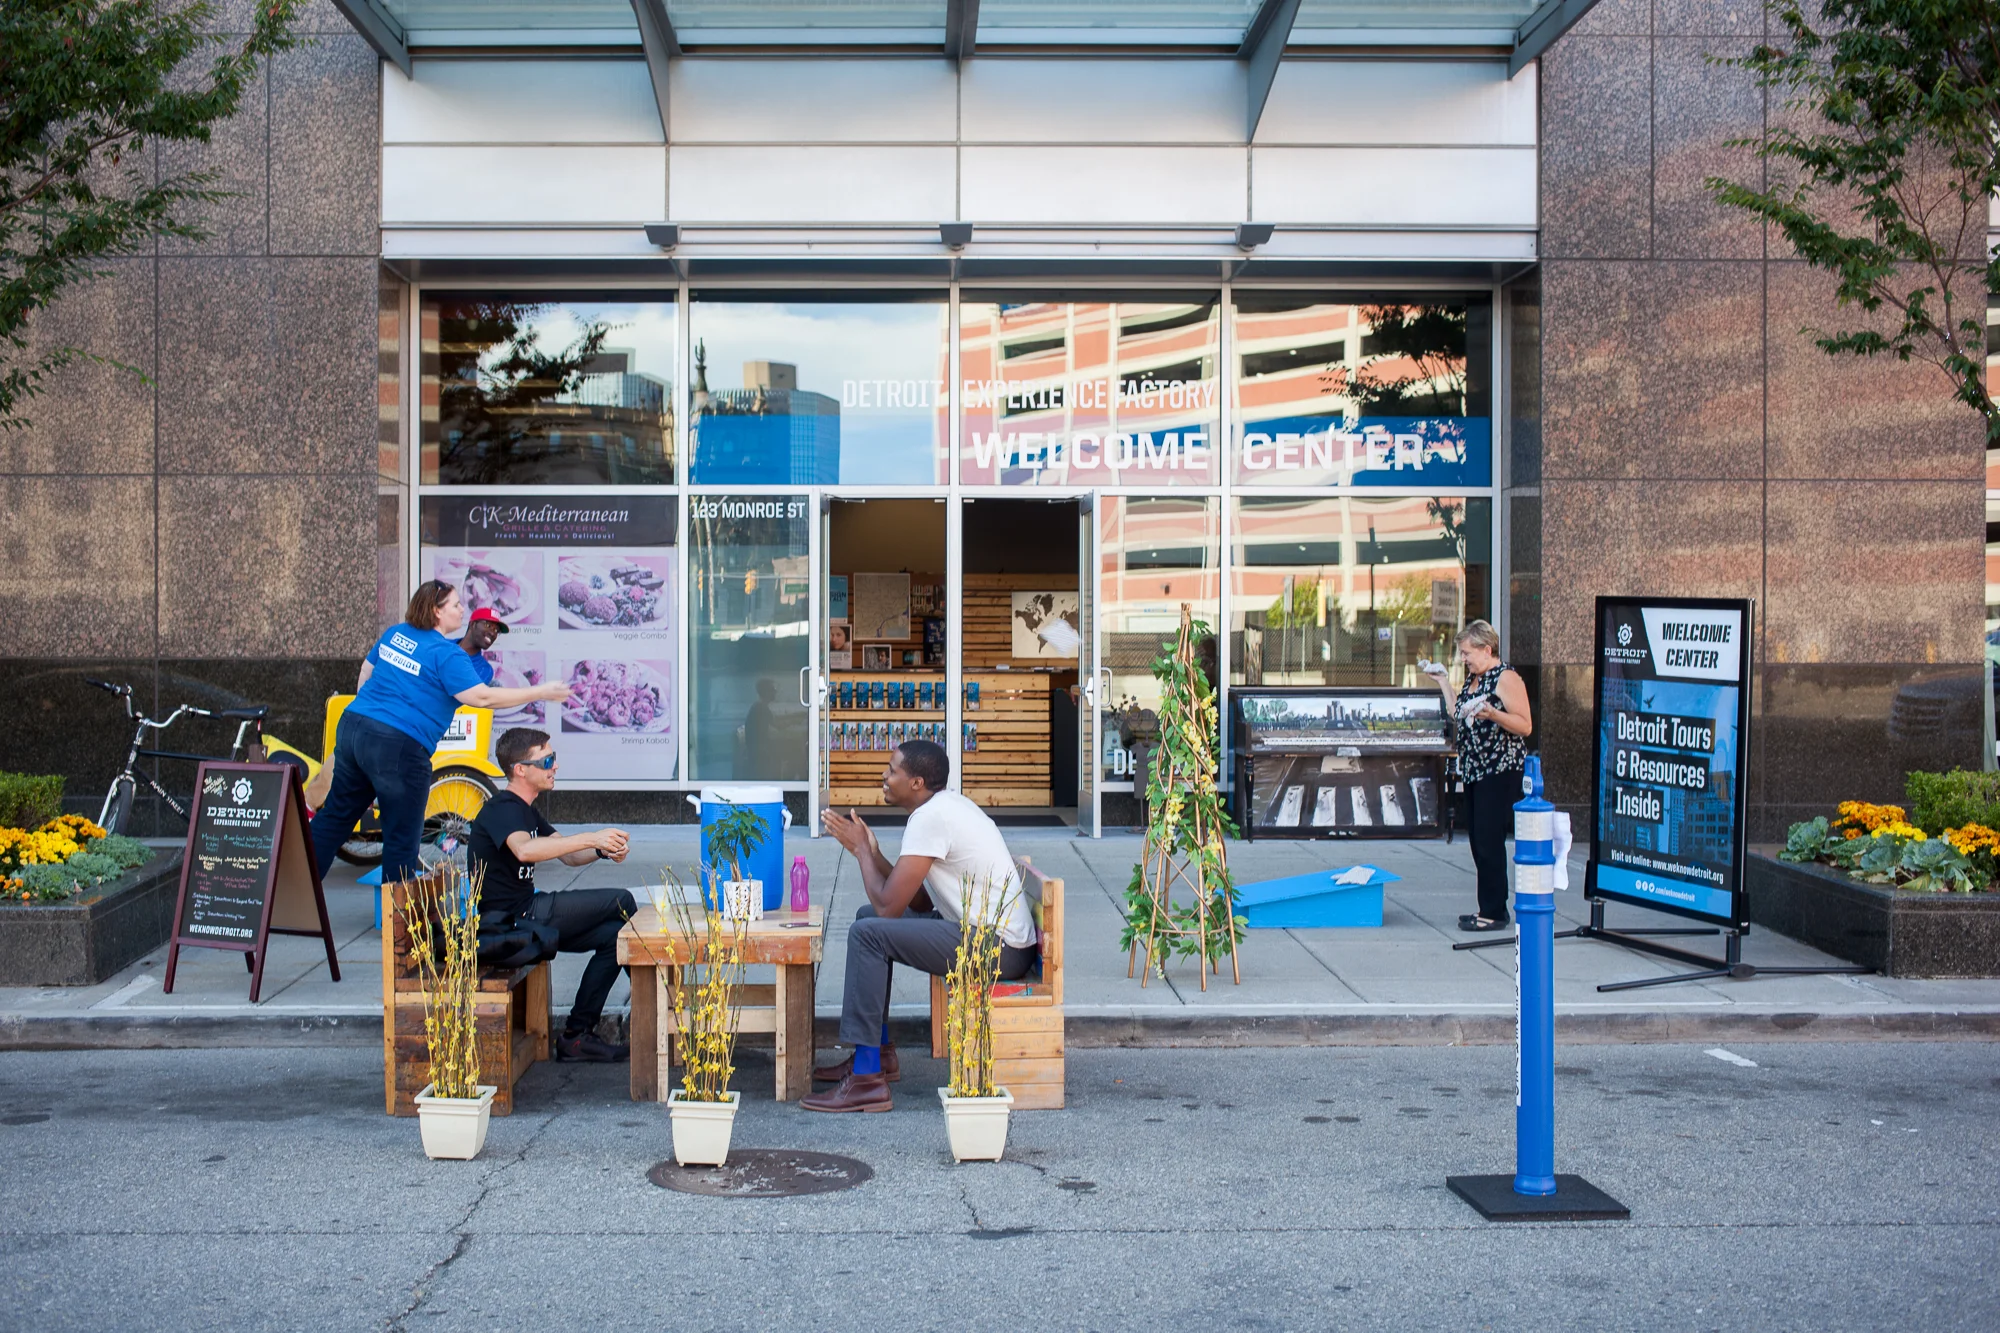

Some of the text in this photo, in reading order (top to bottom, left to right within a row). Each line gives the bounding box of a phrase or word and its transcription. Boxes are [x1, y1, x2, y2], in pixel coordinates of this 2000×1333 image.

[843, 379, 1214, 409] DETROIT EXPERIENCE FACTORY
[972, 432, 1423, 471] WELCOME CENTER
[508, 504, 629, 523] Mediterranean
[692, 502, 805, 518] 123 MONROE ST
[502, 524, 607, 532] GRILLE & CATERING
[529, 532, 561, 541] Healthy
[523, 627, 542, 636] Wrap
[613, 632, 667, 641] Veggie Combo
[1662, 622, 1732, 644] WELCOME
[1604, 647, 1647, 658] DETROIT
[1665, 648, 1718, 669] CENTER
[621, 736, 644, 745] Shrimp
[1617, 712, 1711, 750] Detroit Tours
[1616, 750, 1705, 789] & Resources
[150, 780, 185, 815] MAIN STREET
[1615, 787, 1660, 821] Inside
[206, 806, 271, 820] DETROIT
[1611, 849, 1724, 885] Visit us online: www.weknowdetroit.org
[189, 924, 253, 938] WEKNOWDETROIT.ORG
